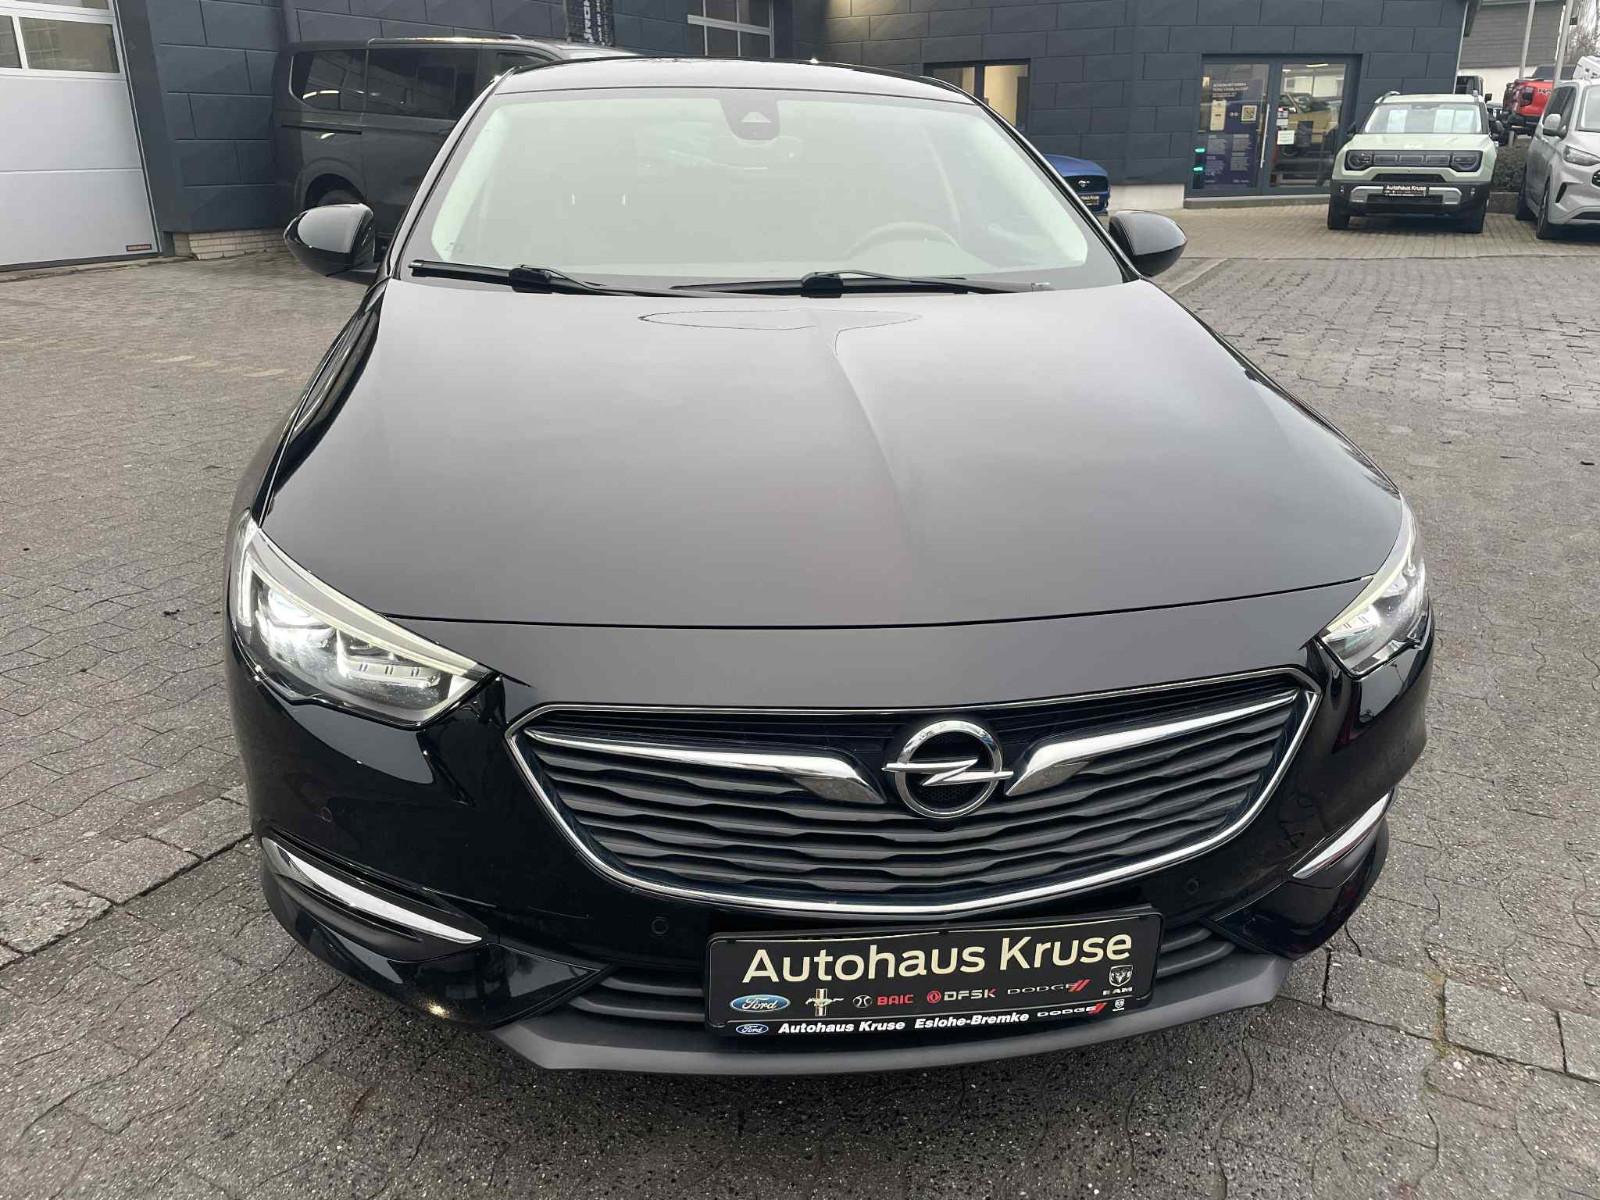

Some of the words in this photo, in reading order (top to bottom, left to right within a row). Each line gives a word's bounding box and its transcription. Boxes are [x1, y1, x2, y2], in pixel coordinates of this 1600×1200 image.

[742, 944, 985, 984] Autohaus
[999, 932, 1132, 971] Kruse
[876, 994, 915, 1006] BAIC
[943, 987, 997, 1001] DFSK
[778, 1021, 855, 1034] Autohaus
[858, 1020, 906, 1033] Kruse
[914, 1011, 1030, 1029] Eslohe-Bremke
